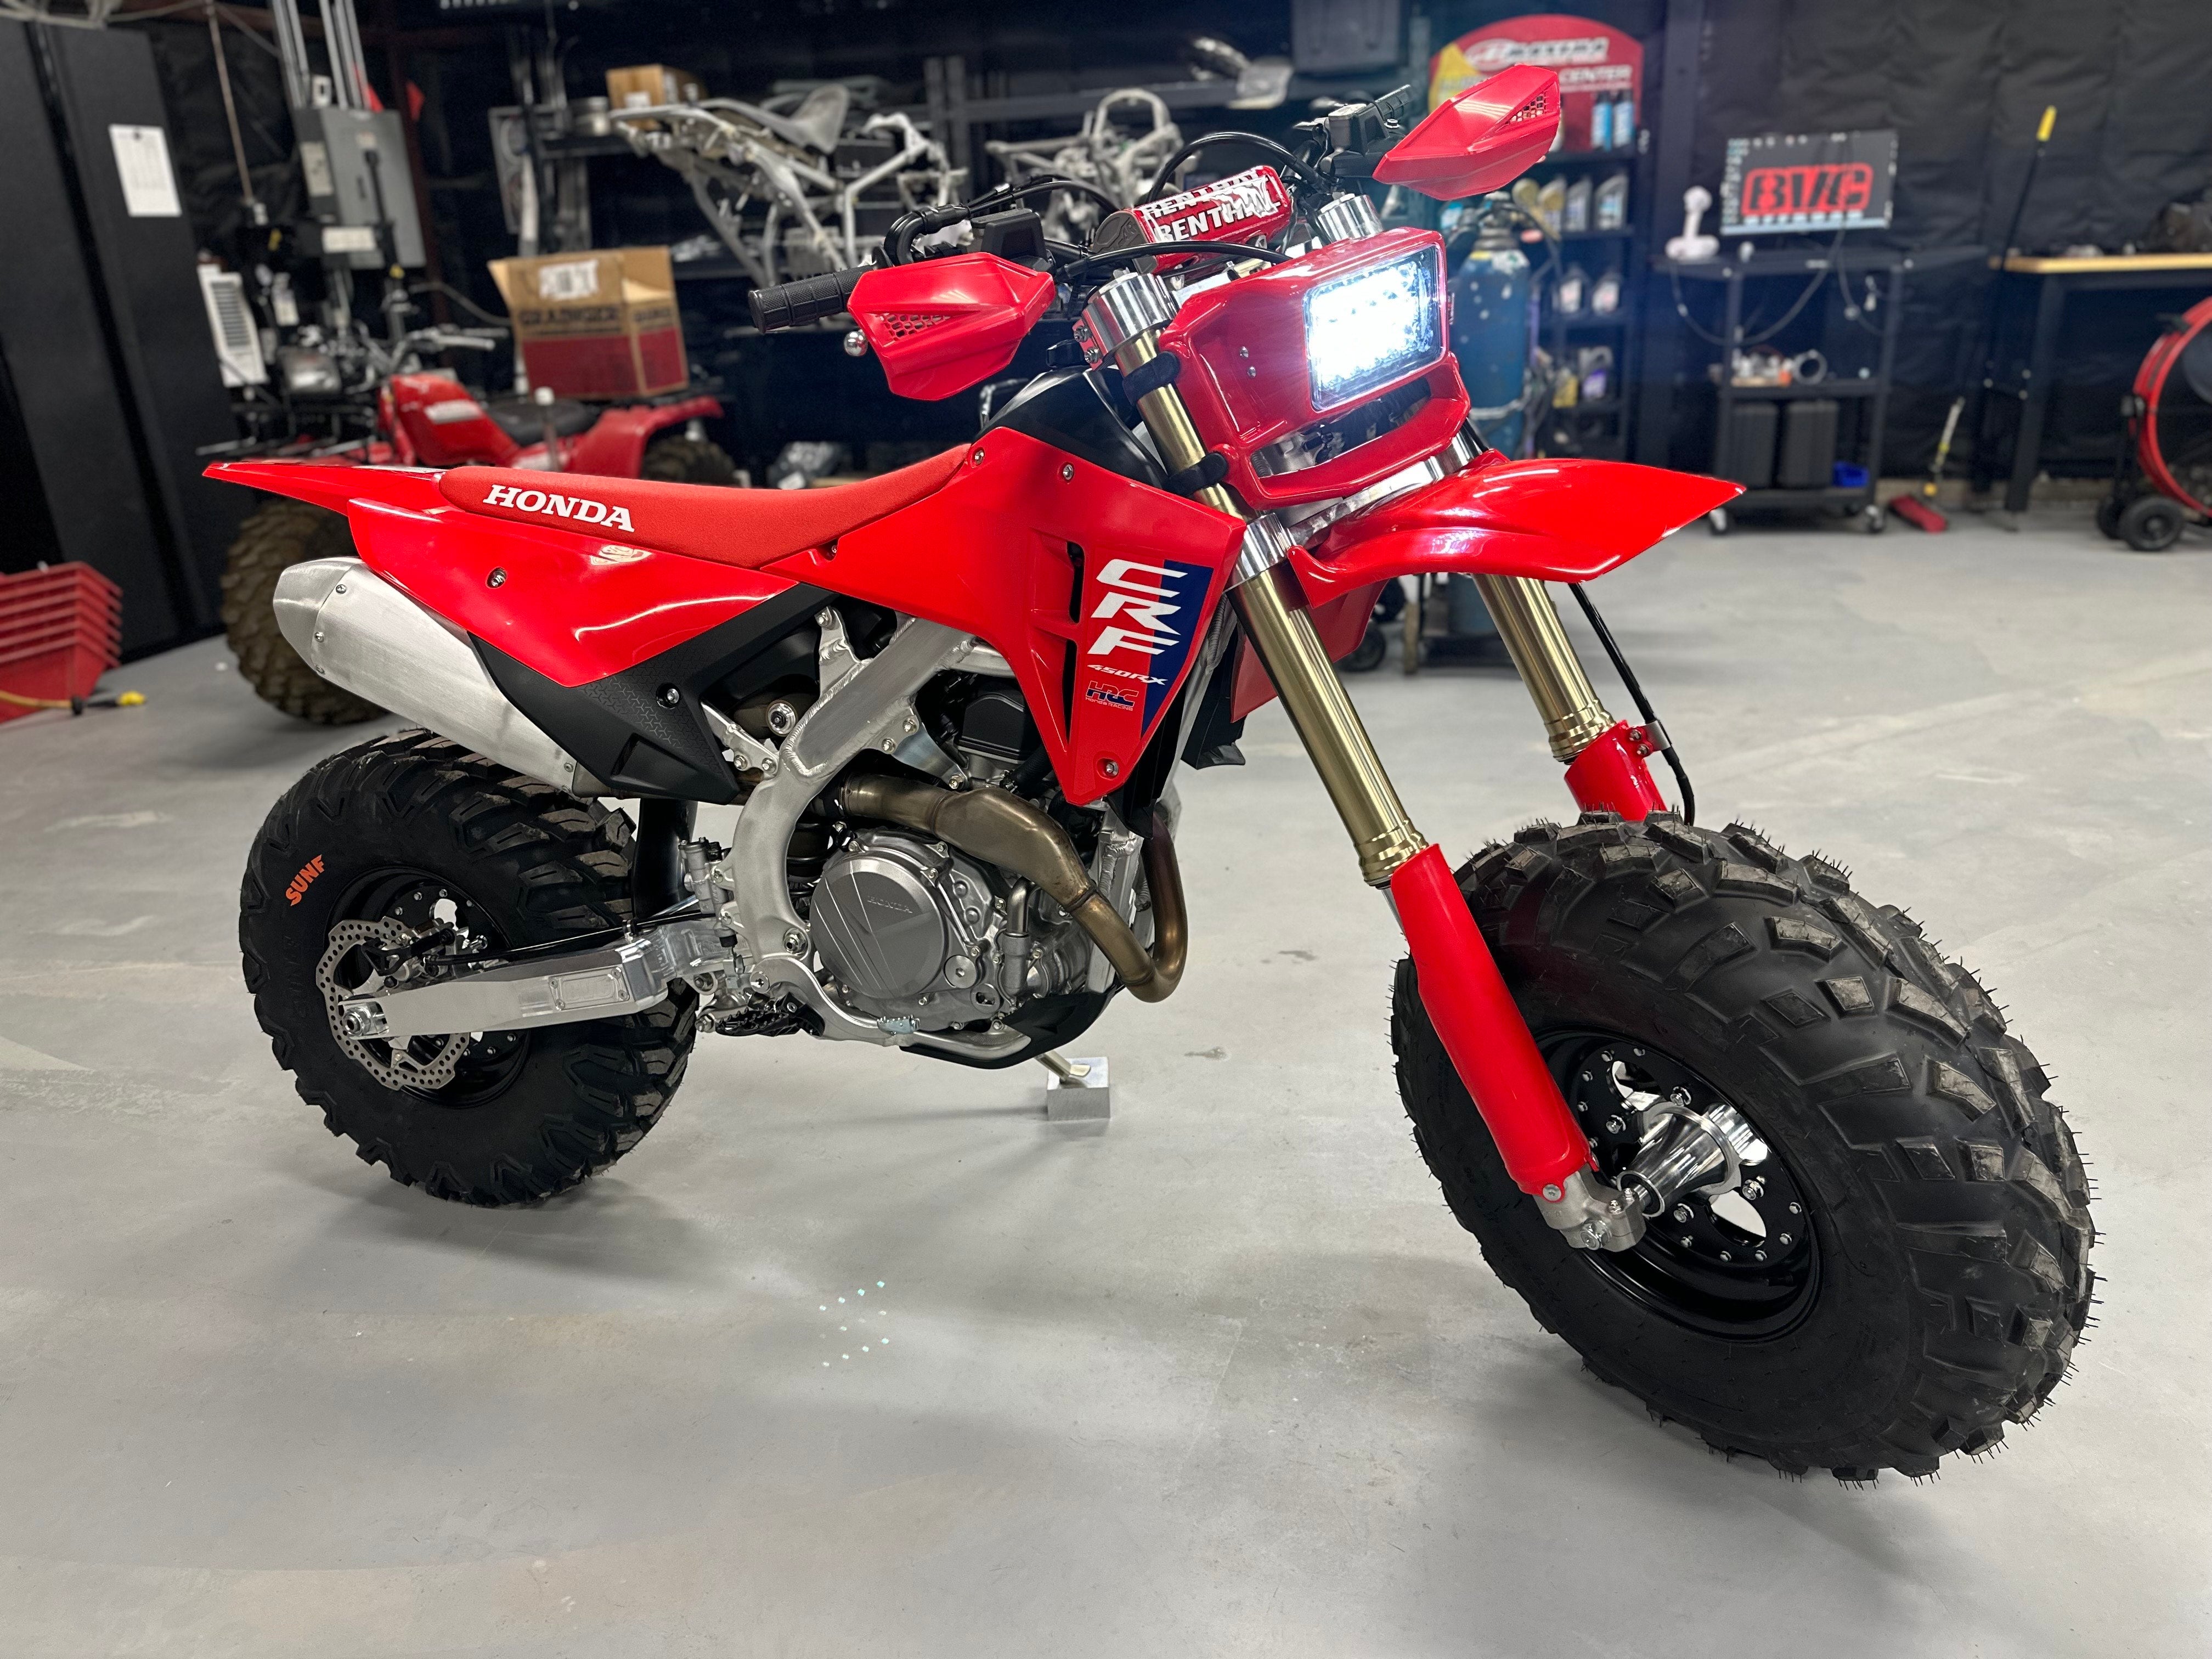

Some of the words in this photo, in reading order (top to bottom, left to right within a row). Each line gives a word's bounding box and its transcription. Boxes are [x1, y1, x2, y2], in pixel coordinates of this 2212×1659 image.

[482, 484, 635, 532] HONDA
[1087, 559, 1188, 655] CRF
[1086, 680, 1139, 708] HRC
[1087, 664, 1168, 686] 450RX
[1085, 697, 1107, 706] Honda
[1108, 703, 1133, 712] RACING
[285, 854, 325, 906] SUNF
